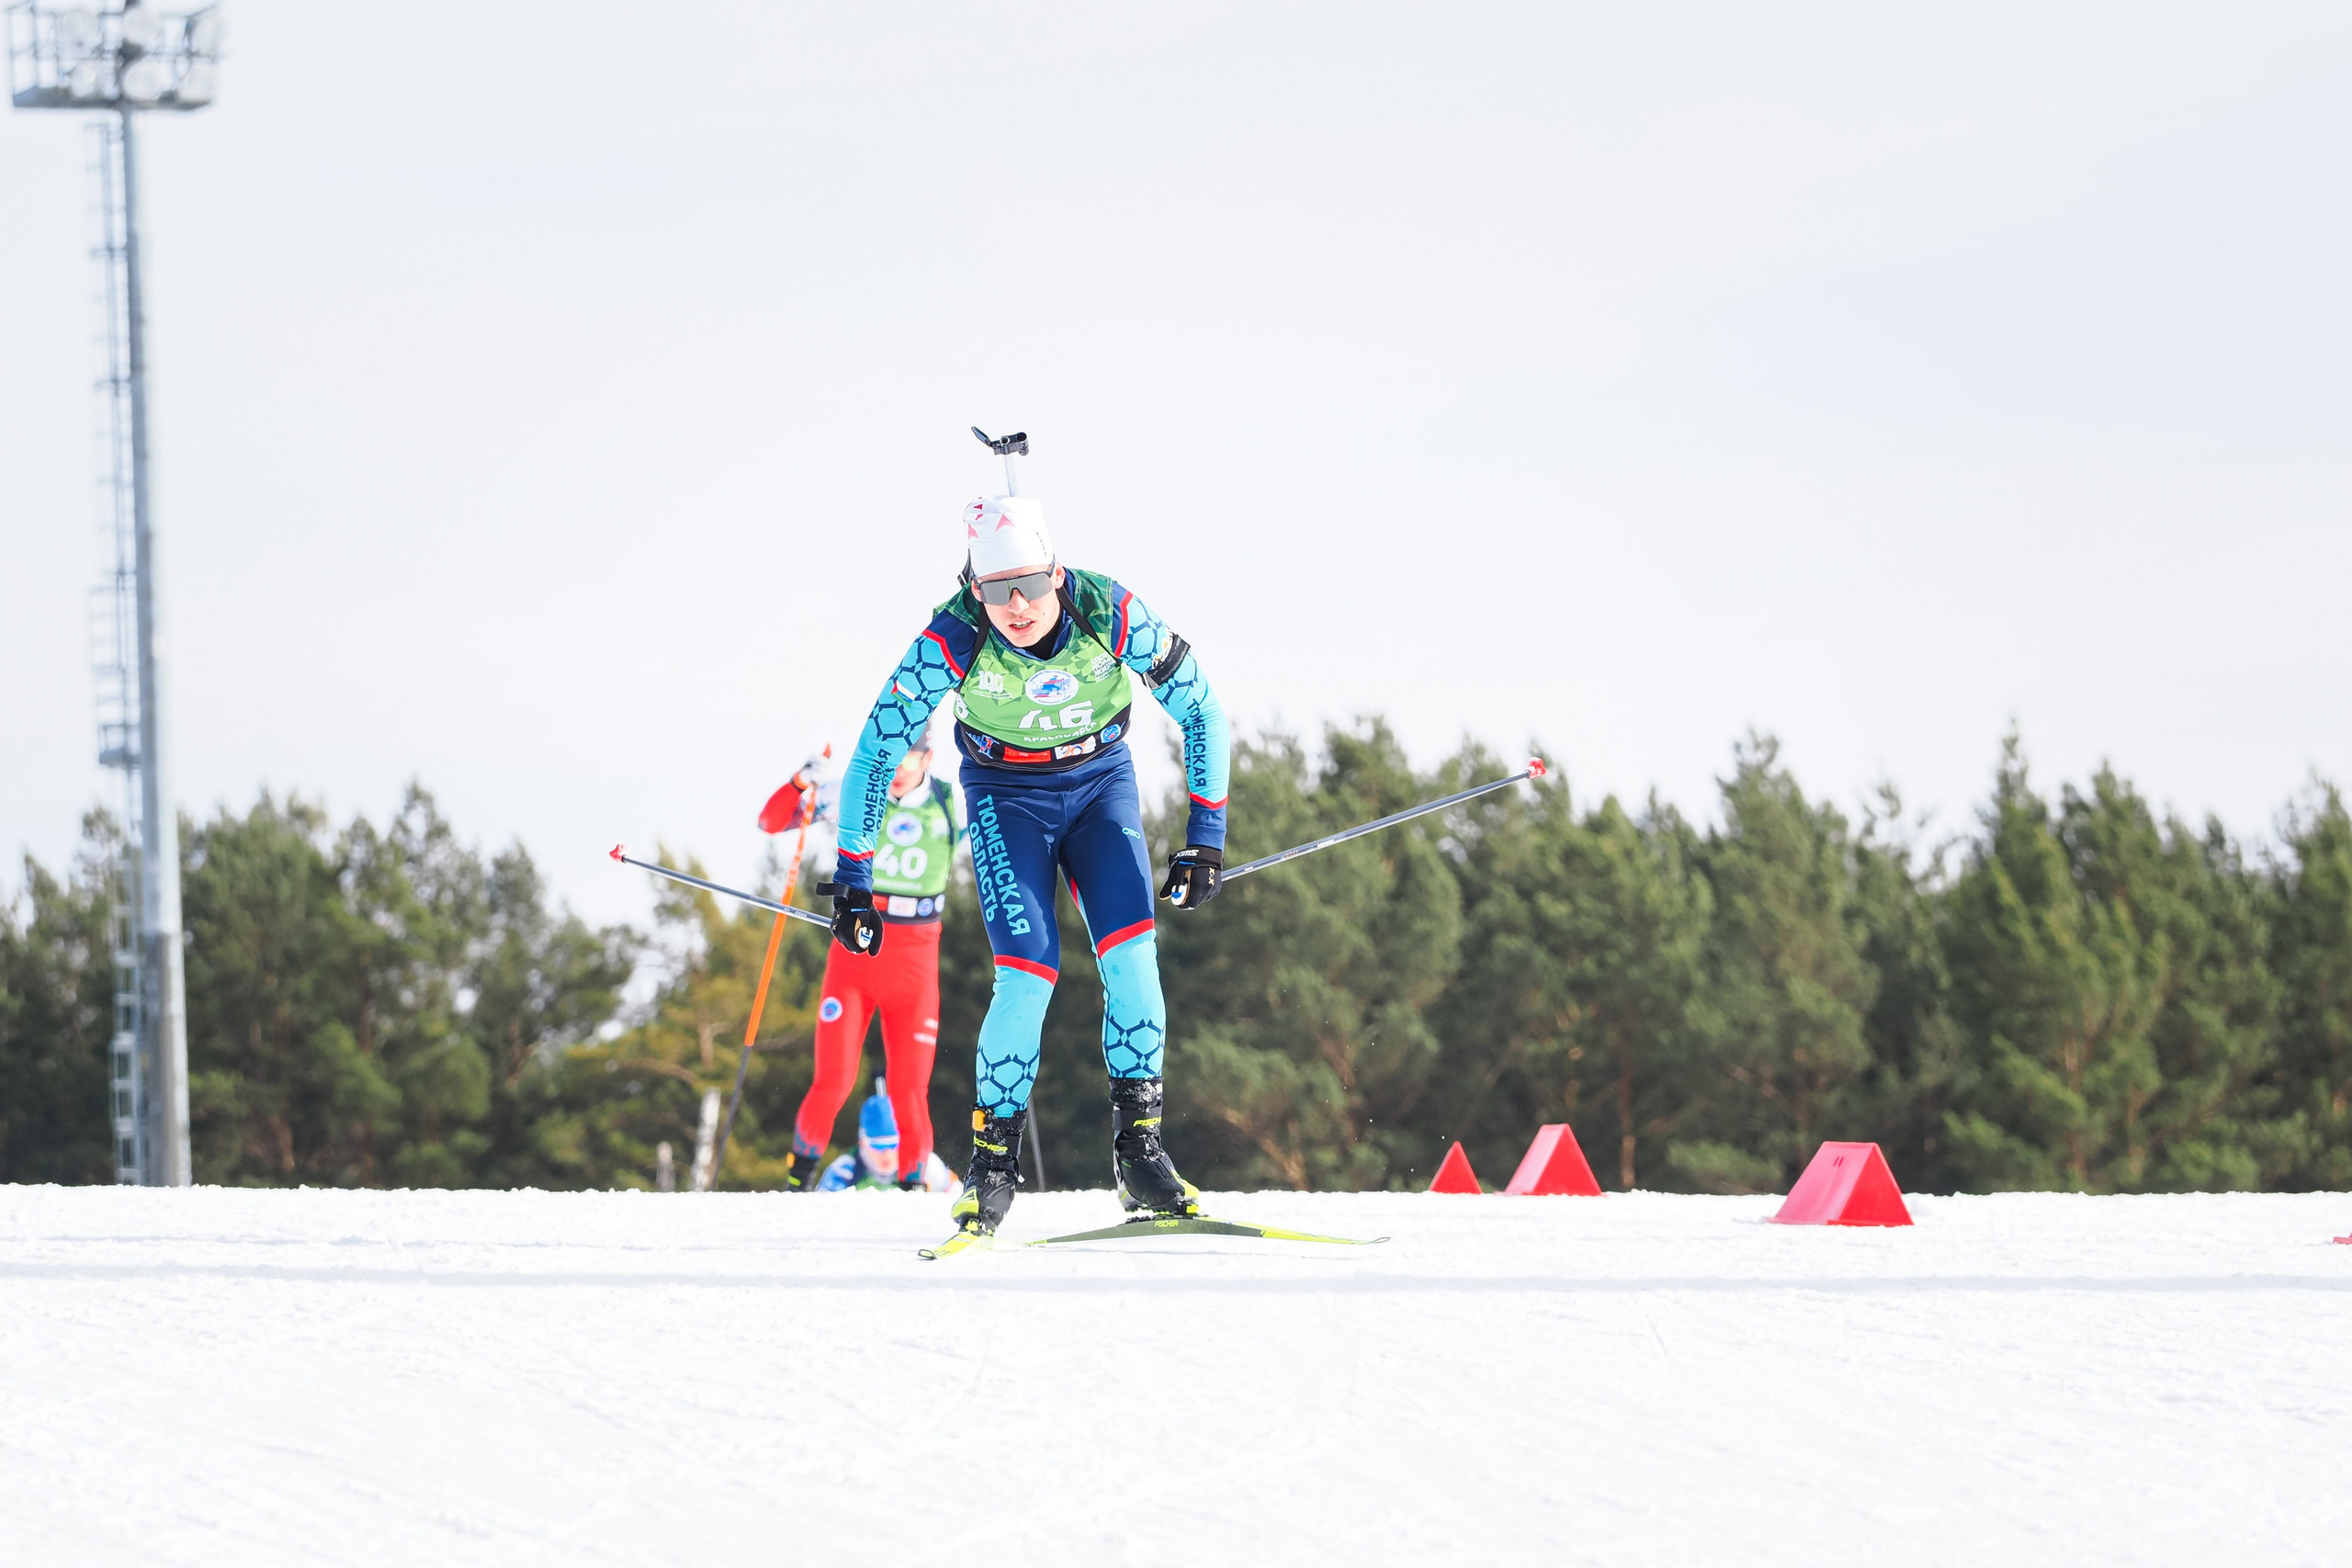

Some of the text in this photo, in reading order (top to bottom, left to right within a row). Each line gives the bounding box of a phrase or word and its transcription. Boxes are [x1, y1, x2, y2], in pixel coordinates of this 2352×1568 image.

[1019, 699, 1095, 731] 46
[874, 843, 928, 879] 40
[969, 822, 999, 922] ОБЛАСТЬ
[977, 795, 1031, 935] ТЮМЕНСКАЯ
[1155, 1220, 1179, 1228] FISCHER
